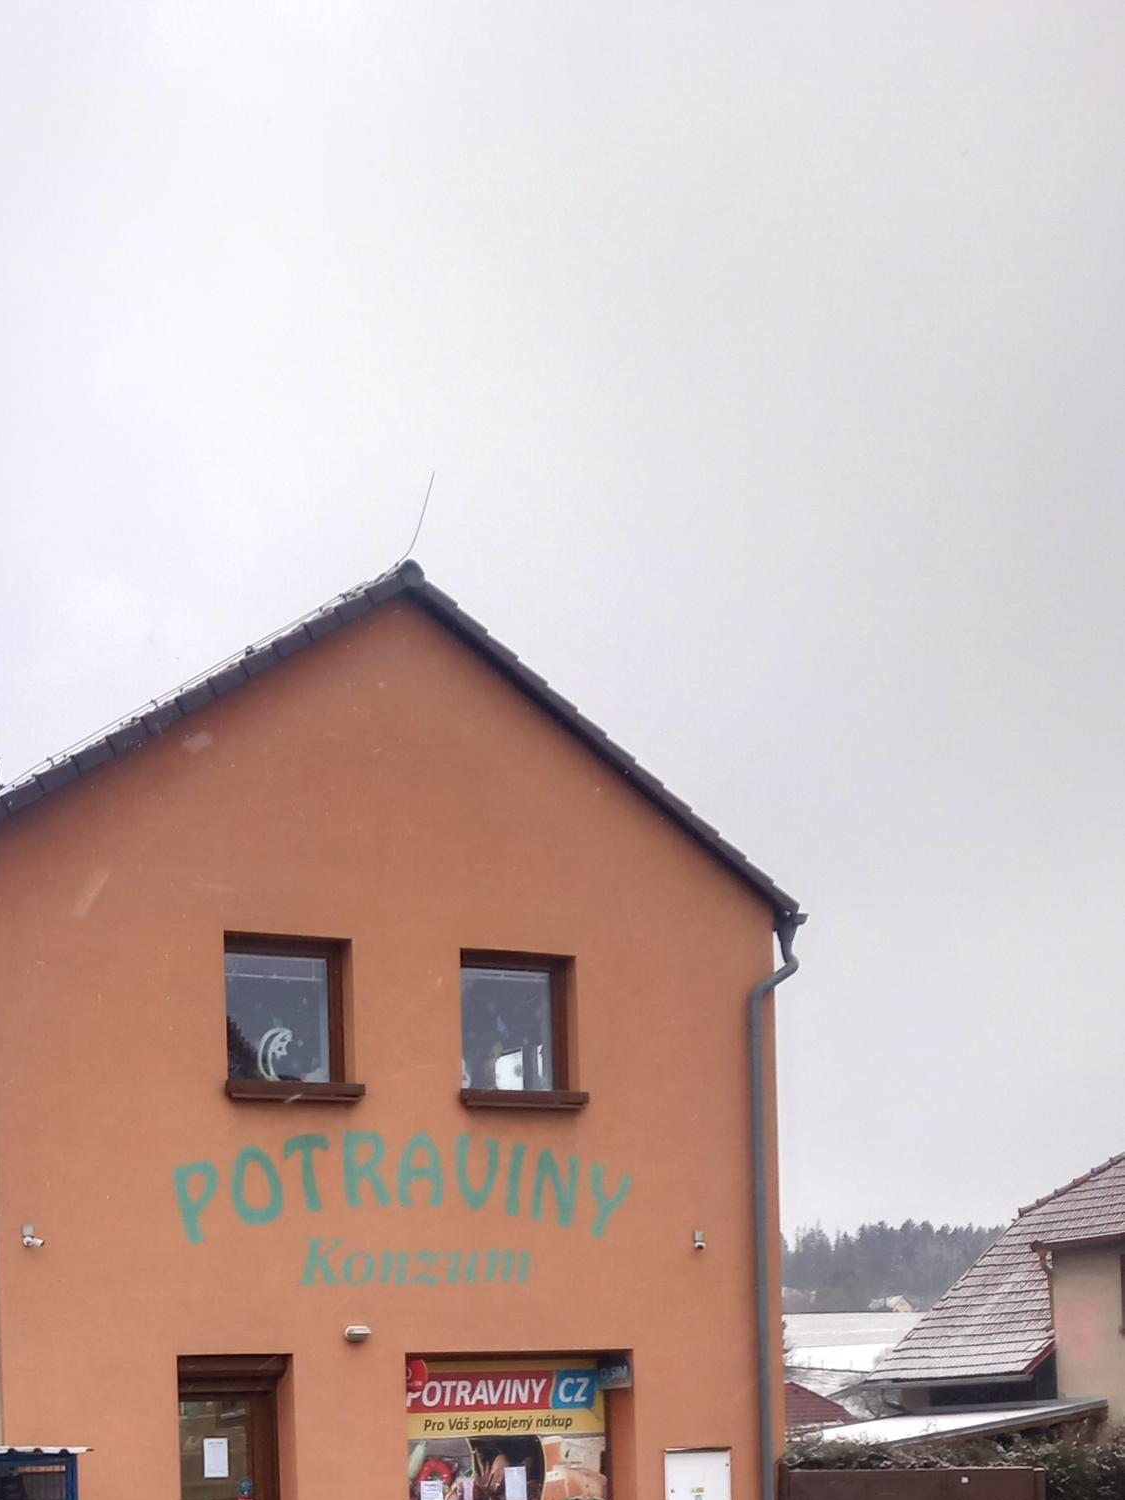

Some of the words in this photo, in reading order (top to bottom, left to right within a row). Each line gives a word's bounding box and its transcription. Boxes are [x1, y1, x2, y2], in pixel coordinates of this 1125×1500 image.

[174, 1131, 632, 1246] POTRAVINY
[299, 1237, 532, 1287] Konzum
[406, 1378, 547, 1408] POTRAVINY
[558, 1377, 589, 1403] CZ
[423, 1419, 444, 1431] Pro
[448, 1417, 470, 1431] Váš
[472, 1415, 534, 1432] spokojený
[536, 1415, 573, 1429] nákup
